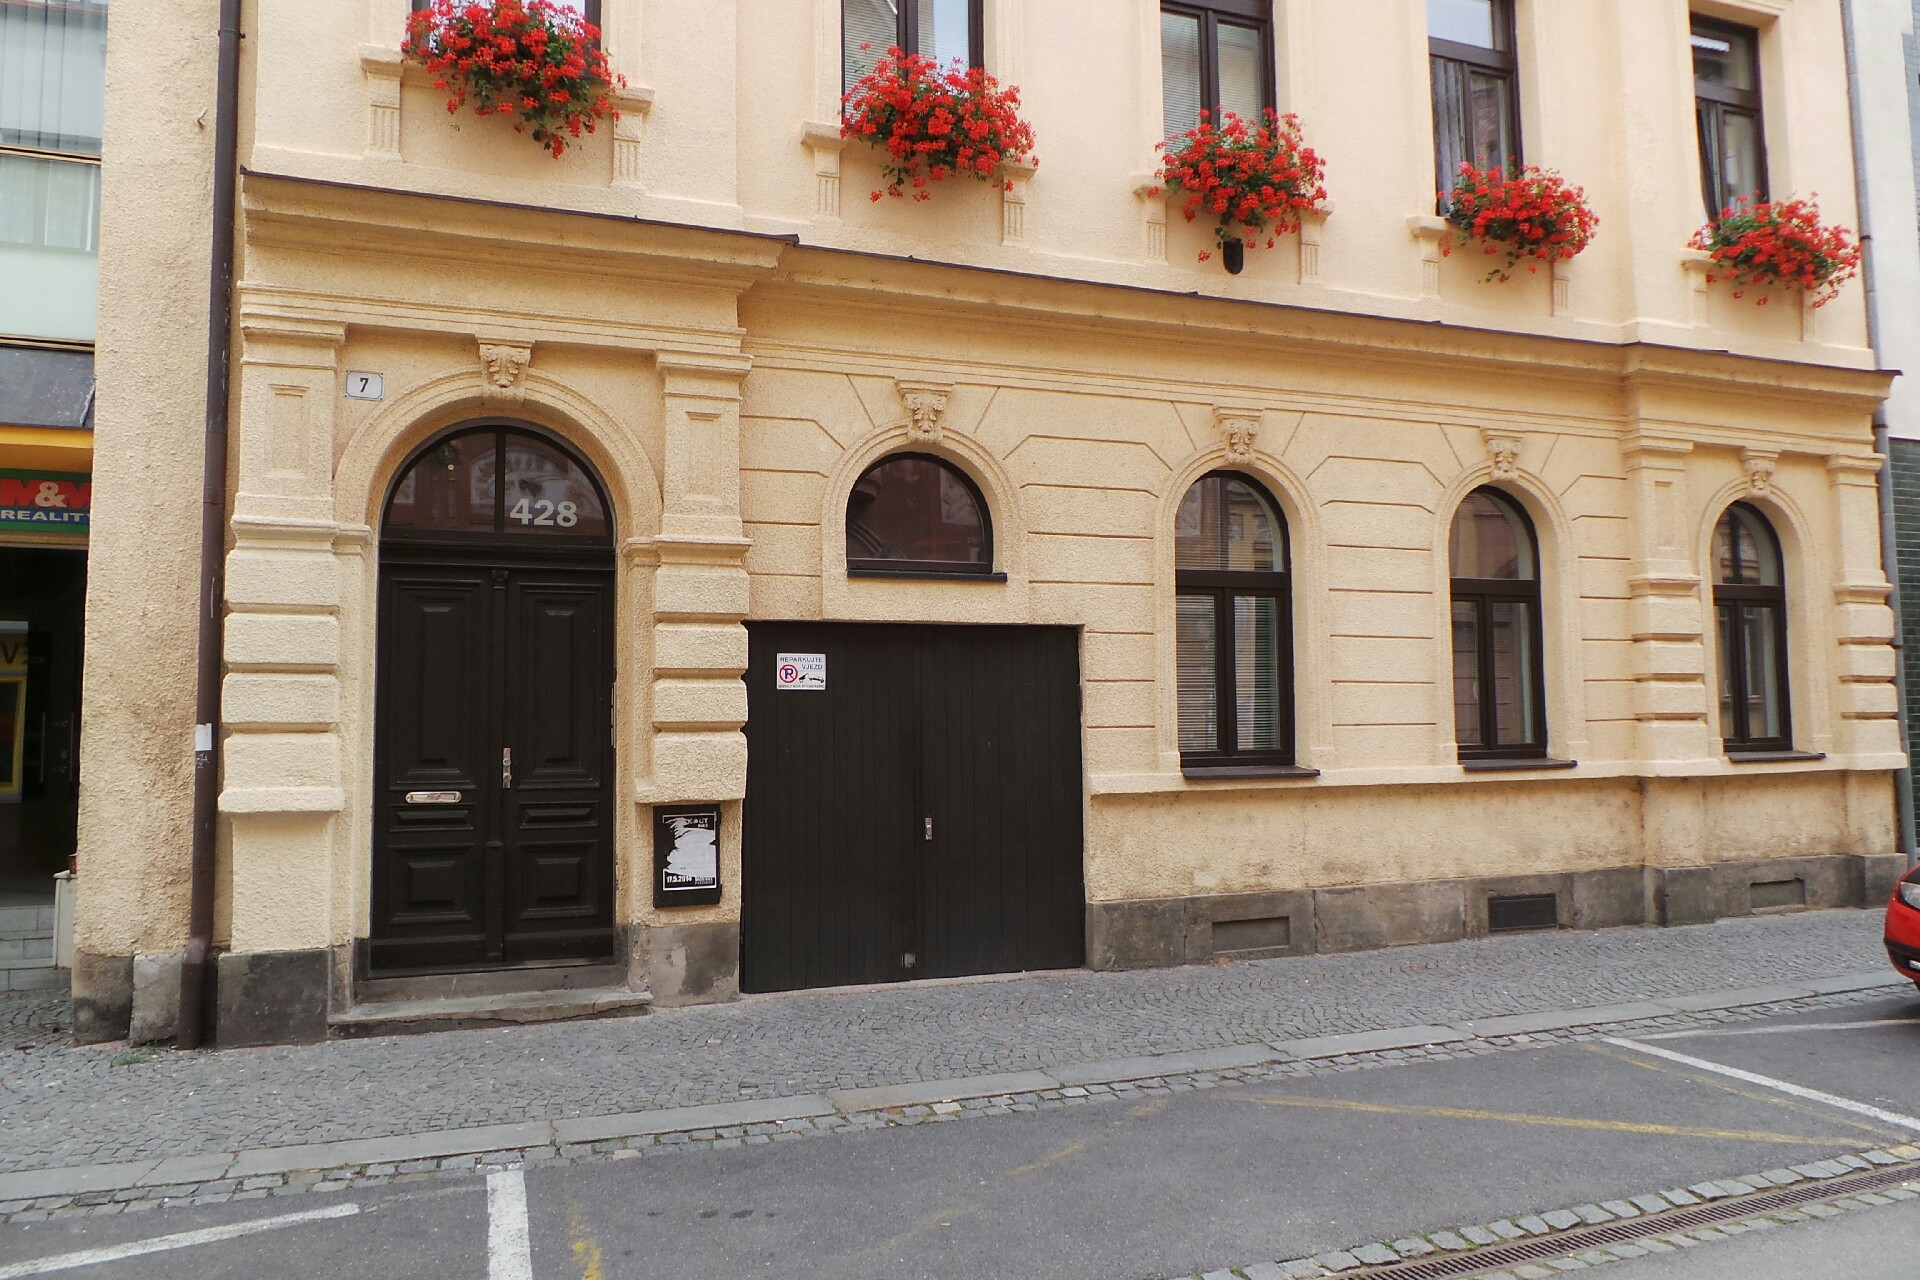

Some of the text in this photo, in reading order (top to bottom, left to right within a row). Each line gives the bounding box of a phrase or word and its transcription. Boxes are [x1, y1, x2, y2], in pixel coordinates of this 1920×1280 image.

[359, 377, 369, 393] 7
[1, 510, 91, 522] REALIT
[510, 498, 578, 527] 428
